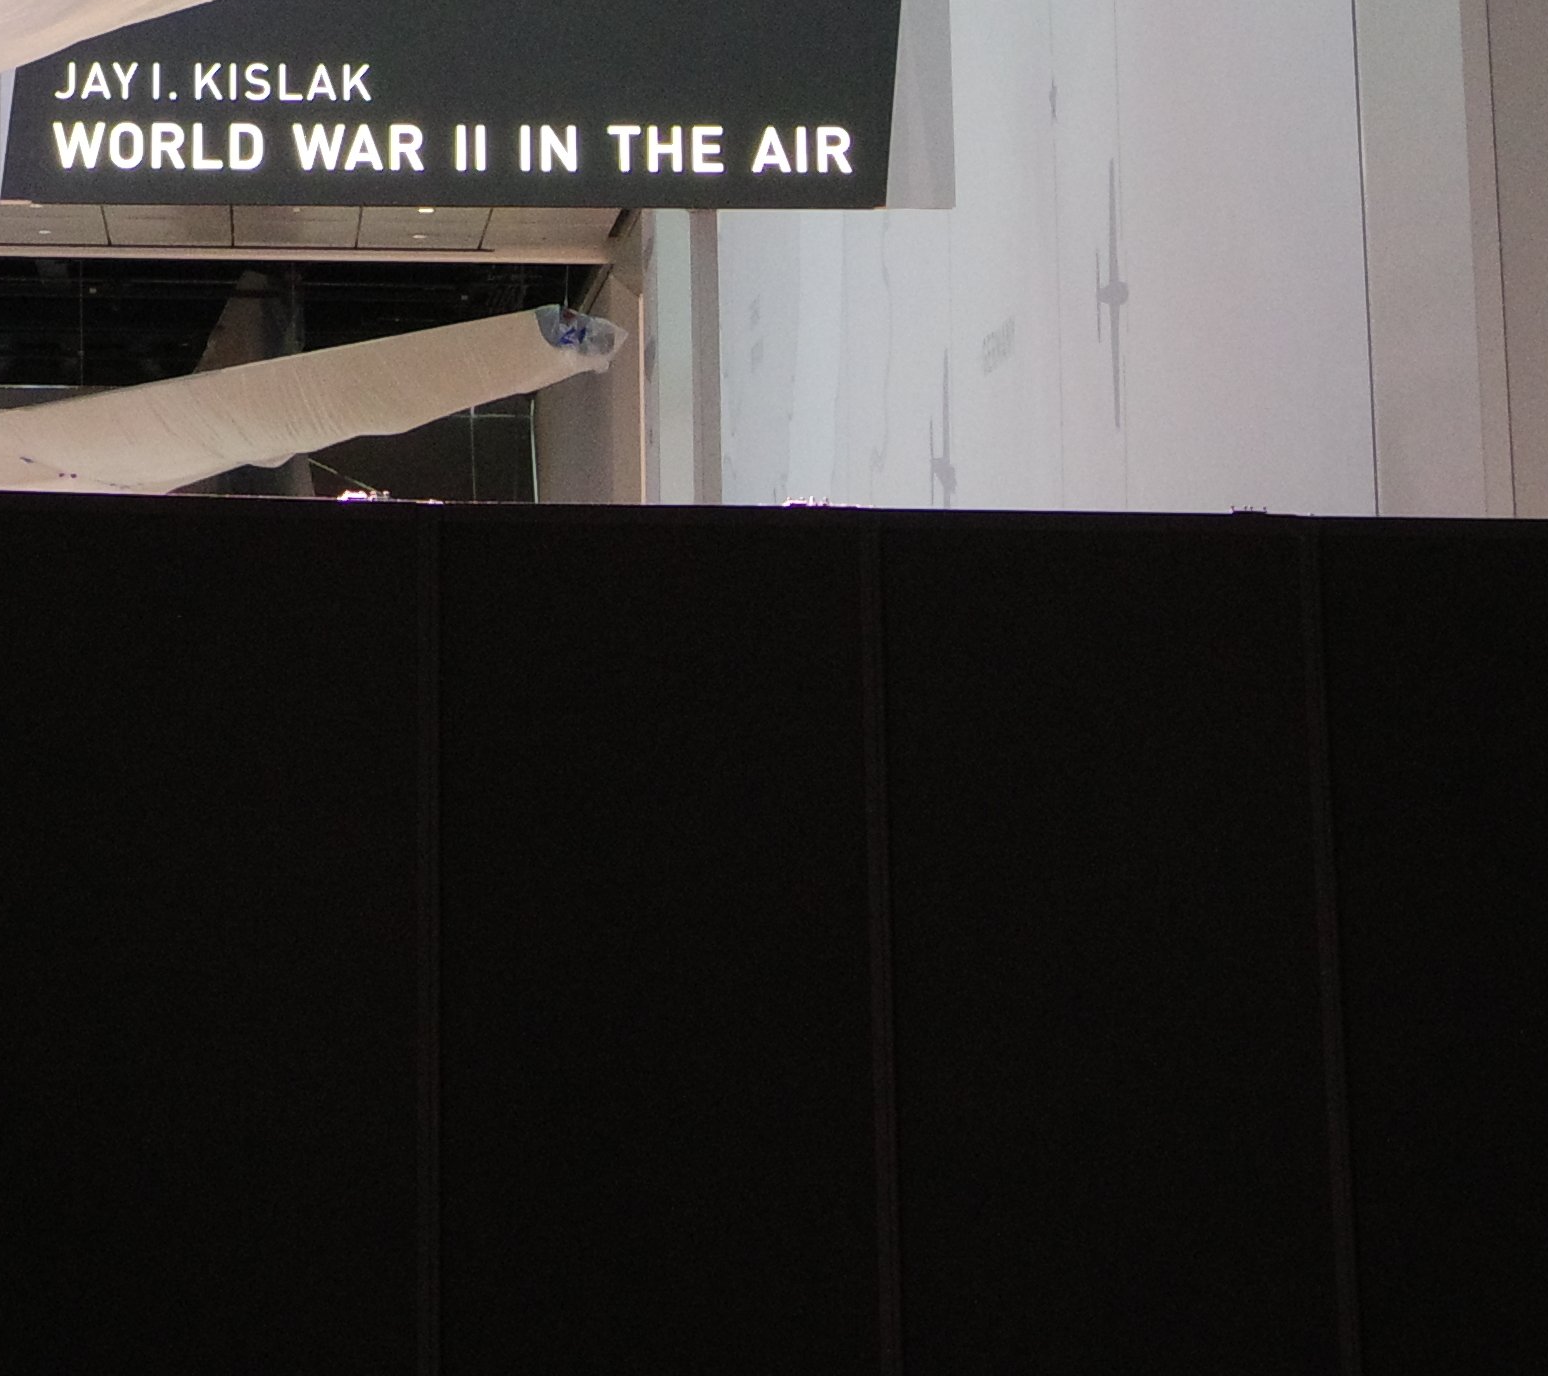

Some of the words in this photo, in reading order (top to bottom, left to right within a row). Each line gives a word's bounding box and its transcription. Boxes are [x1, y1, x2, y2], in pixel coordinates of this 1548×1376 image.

[54, 61, 139, 101] JAY
[151, 62, 178, 101] I.
[193, 62, 372, 102] KISLAK
[52, 121, 264, 171] WORLD
[292, 123, 426, 171] WAR
[455, 124, 487, 172] II
[519, 125, 577, 172] IN
[607, 125, 726, 174] THE
[751, 126, 853, 174] AIR
